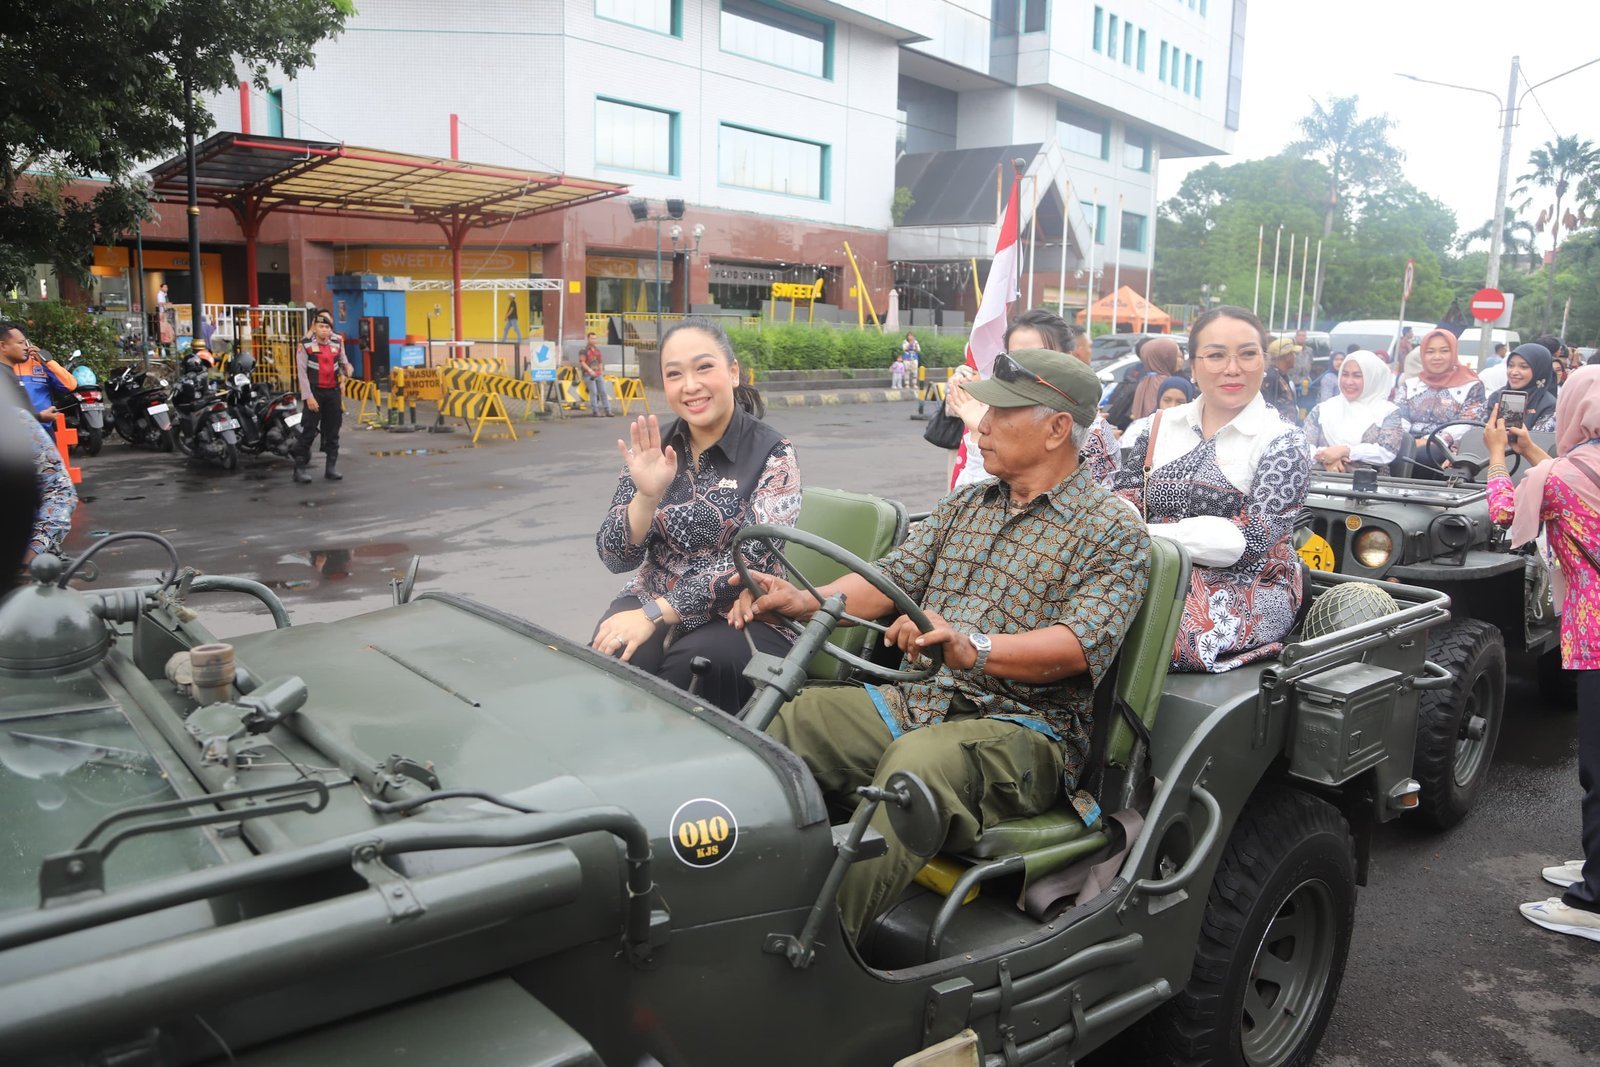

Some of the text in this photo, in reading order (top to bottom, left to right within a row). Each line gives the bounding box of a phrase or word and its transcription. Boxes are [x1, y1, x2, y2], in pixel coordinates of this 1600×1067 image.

[381, 253, 434, 268] SWEET
[409, 369, 437, 378] MASUK
[412, 380, 440, 388] MOTOR
[678, 815, 729, 848] 010
[696, 845, 719, 858] KJS
